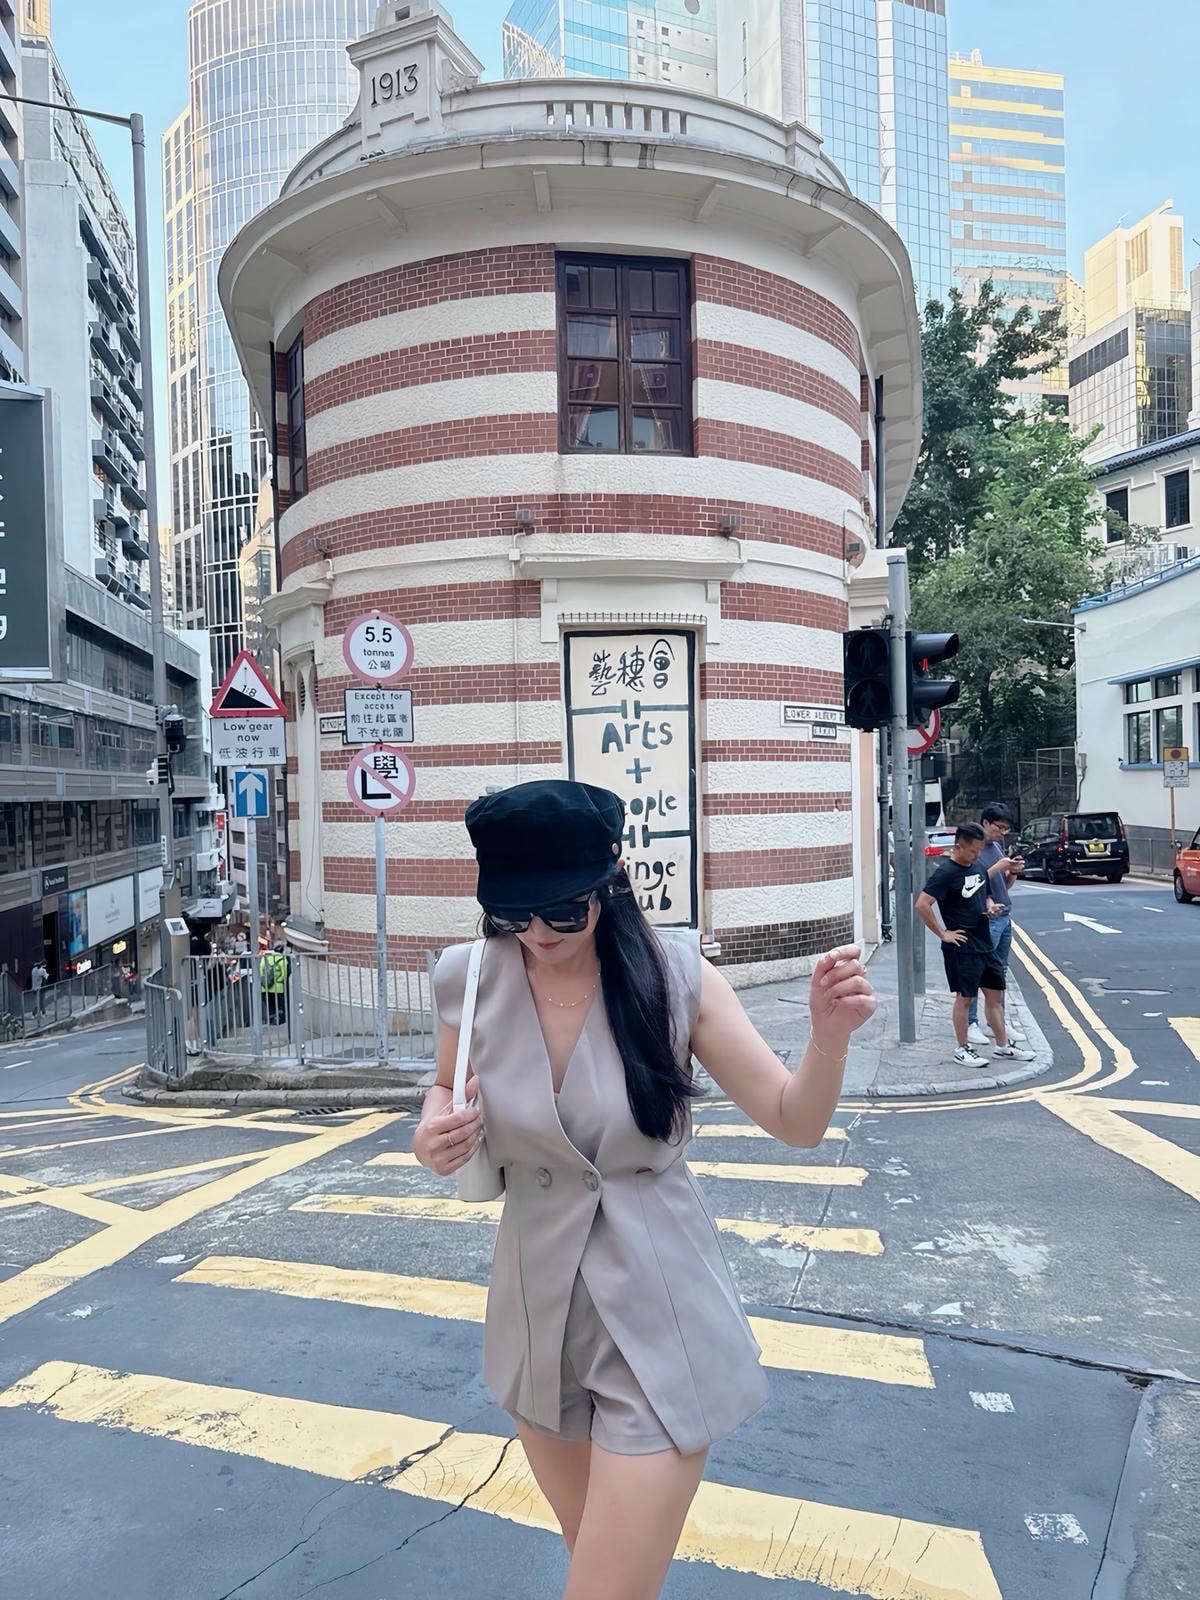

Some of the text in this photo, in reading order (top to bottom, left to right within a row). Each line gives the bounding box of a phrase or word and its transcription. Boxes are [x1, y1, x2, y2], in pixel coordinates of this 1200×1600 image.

[371, 64, 418, 107] 1913
[365, 626, 393, 643] 5.5
[363, 648, 395, 657] tonnes
[354, 692, 403, 701] Except for
[364, 702, 395, 710] access
[223, 722, 273, 732] Low gear
[601, 721, 673, 754] Arts
[218, 747, 281, 759] 低波行車
[622, 789, 678, 822] ople
[626, 856, 677, 891] inge
[639, 884, 673, 911] ub
